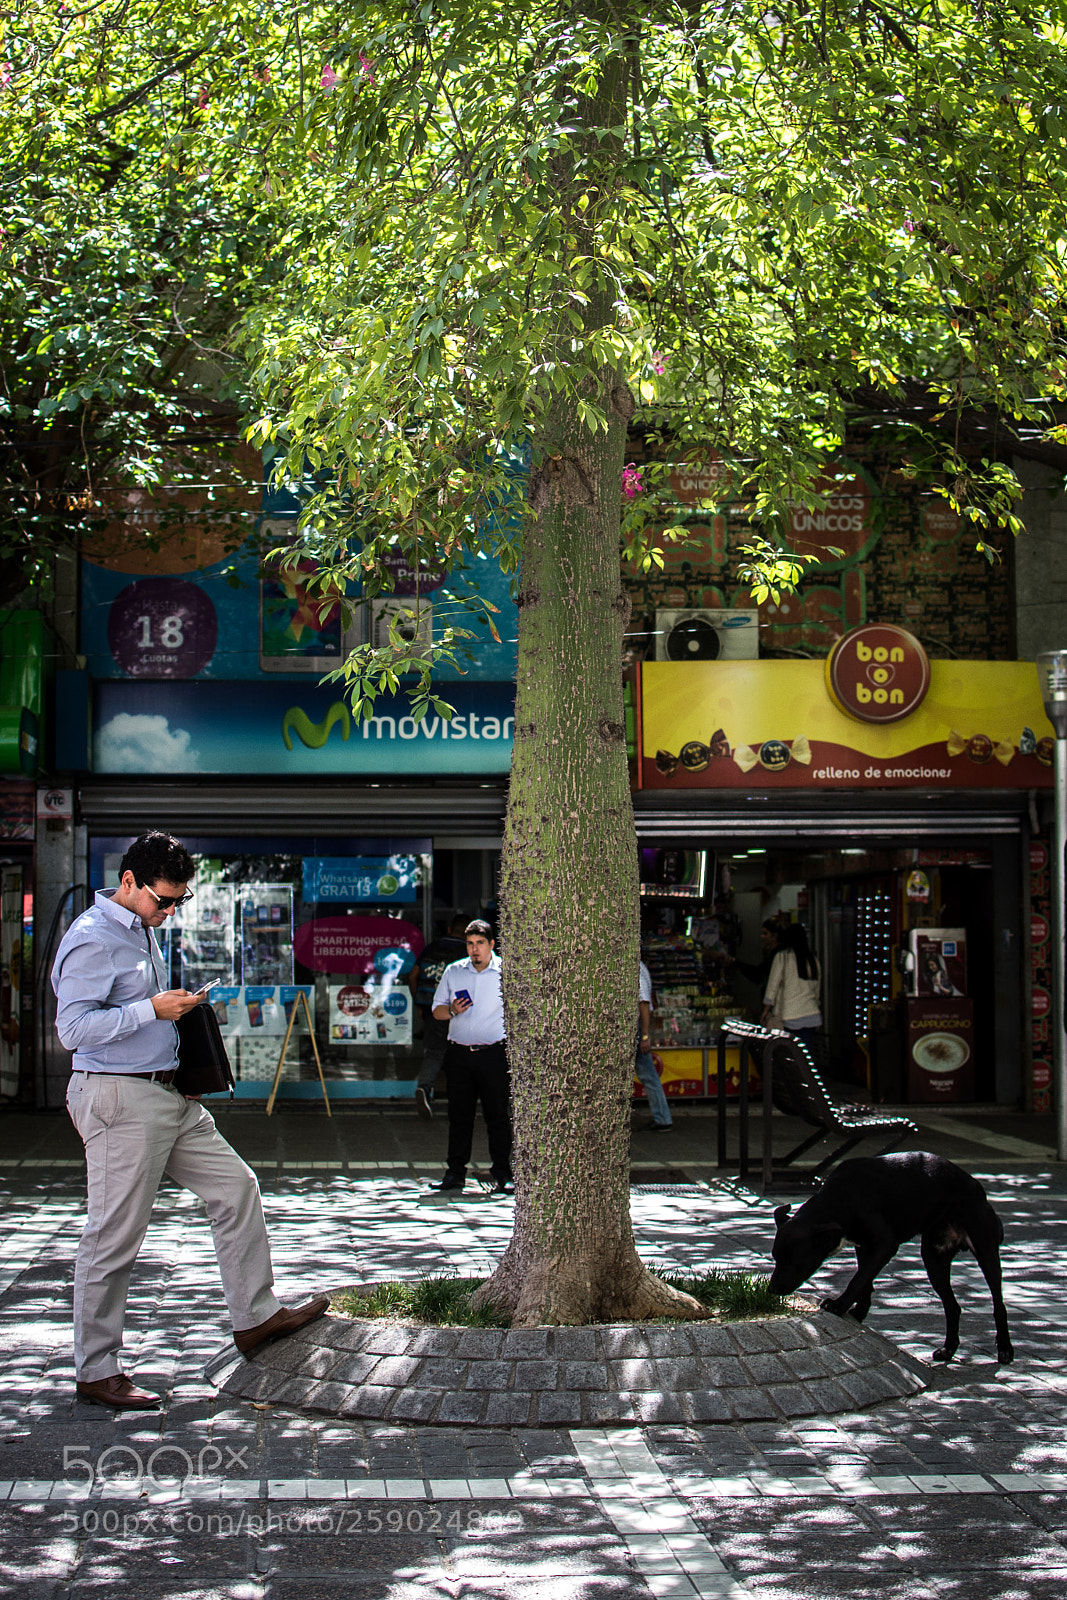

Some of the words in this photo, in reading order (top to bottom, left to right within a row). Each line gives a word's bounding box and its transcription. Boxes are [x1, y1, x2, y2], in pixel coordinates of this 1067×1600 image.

[786, 493, 864, 510] ICOS
[793, 510, 863, 531] ÚNICOS
[138, 615, 184, 648] 18
[856, 641, 904, 662] bon
[856, 682, 904, 704] bon
[361, 712, 515, 740] movistar
[812, 766, 860, 779] relleno
[864, 766, 881, 779] de
[884, 766, 952, 779] emociones
[320, 885, 371, 897] GRATIS
[313, 936, 391, 946] SMARTPHONES
[313, 947, 371, 957] LIBERADOS
